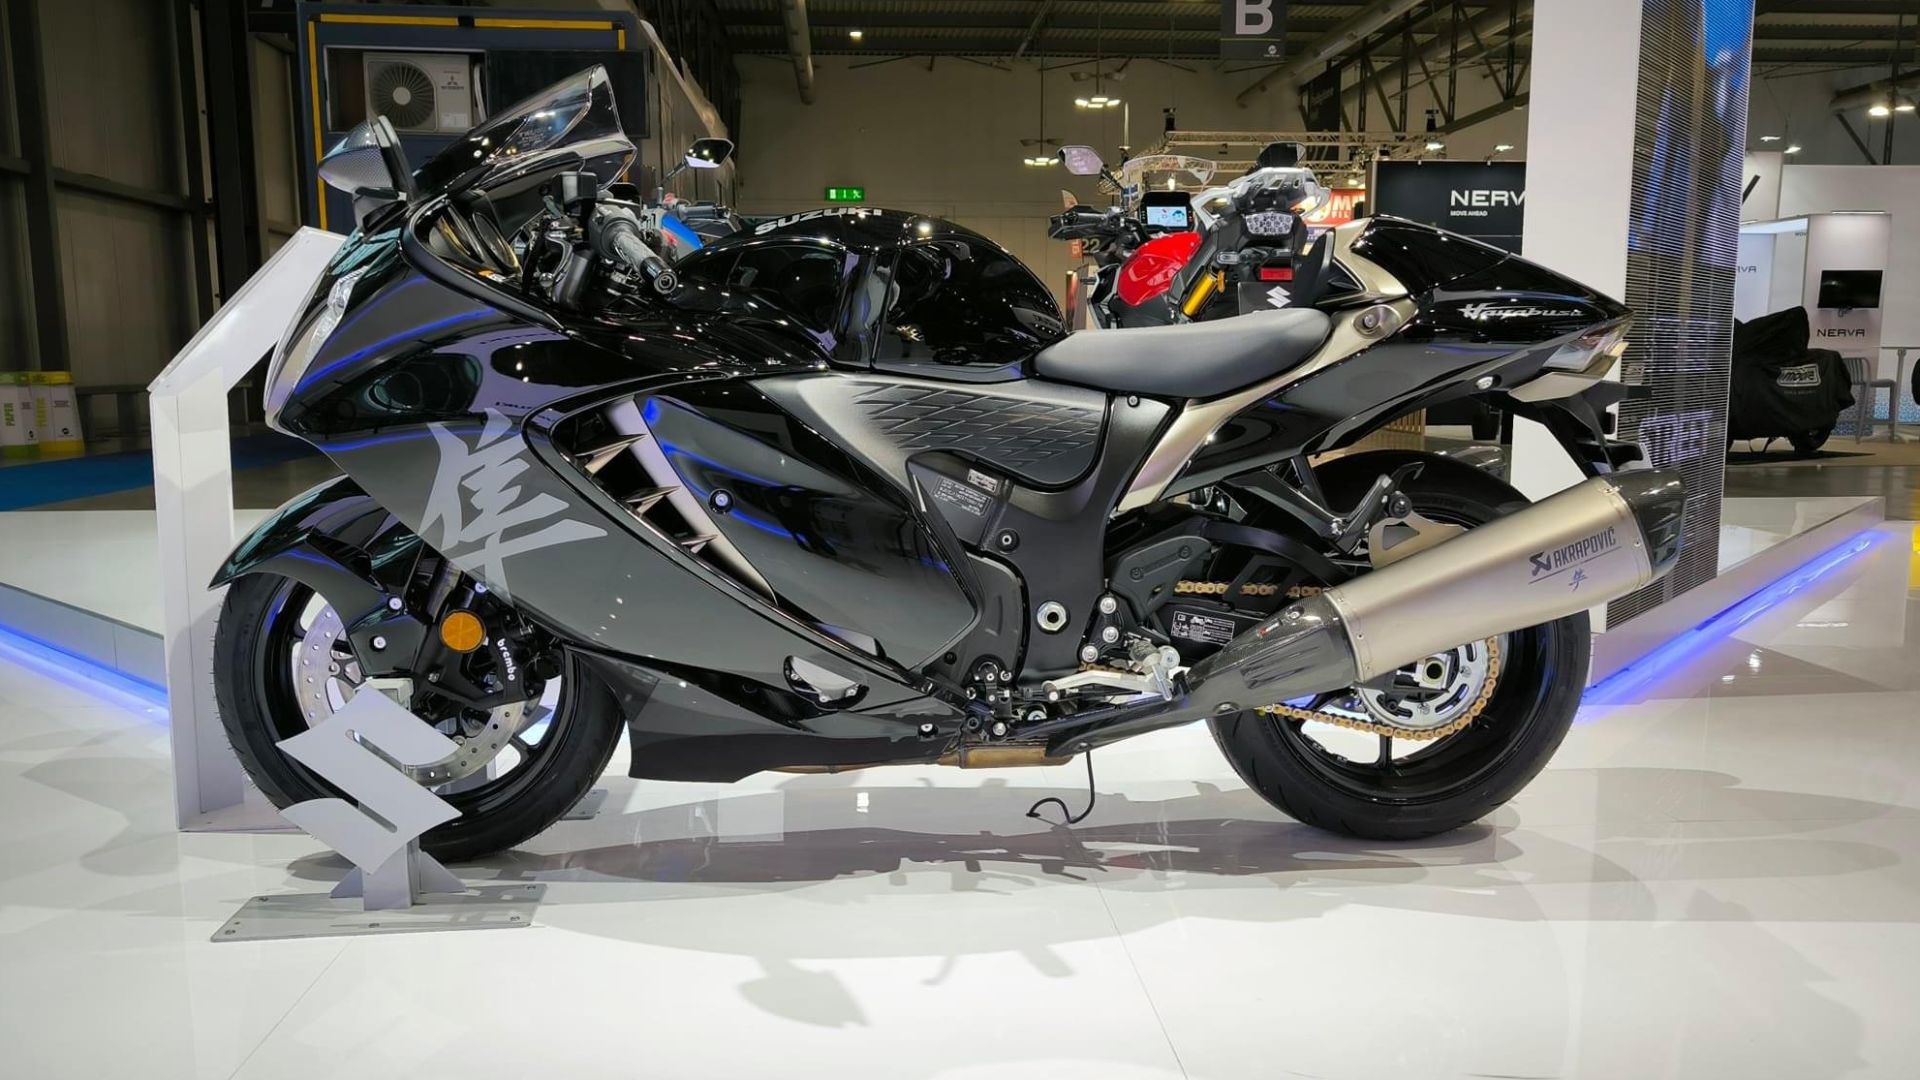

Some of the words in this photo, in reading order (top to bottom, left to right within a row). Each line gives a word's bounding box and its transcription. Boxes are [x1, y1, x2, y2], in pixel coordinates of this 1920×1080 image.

[1235, 0, 1273, 35] B
[754, 207, 882, 235] SUZUKI
[1457, 302, 1586, 320] Hayabusa
[1816, 328, 1865, 337] NERVA
[418, 407, 609, 601] 隼
[497, 638, 517, 681] brembo
